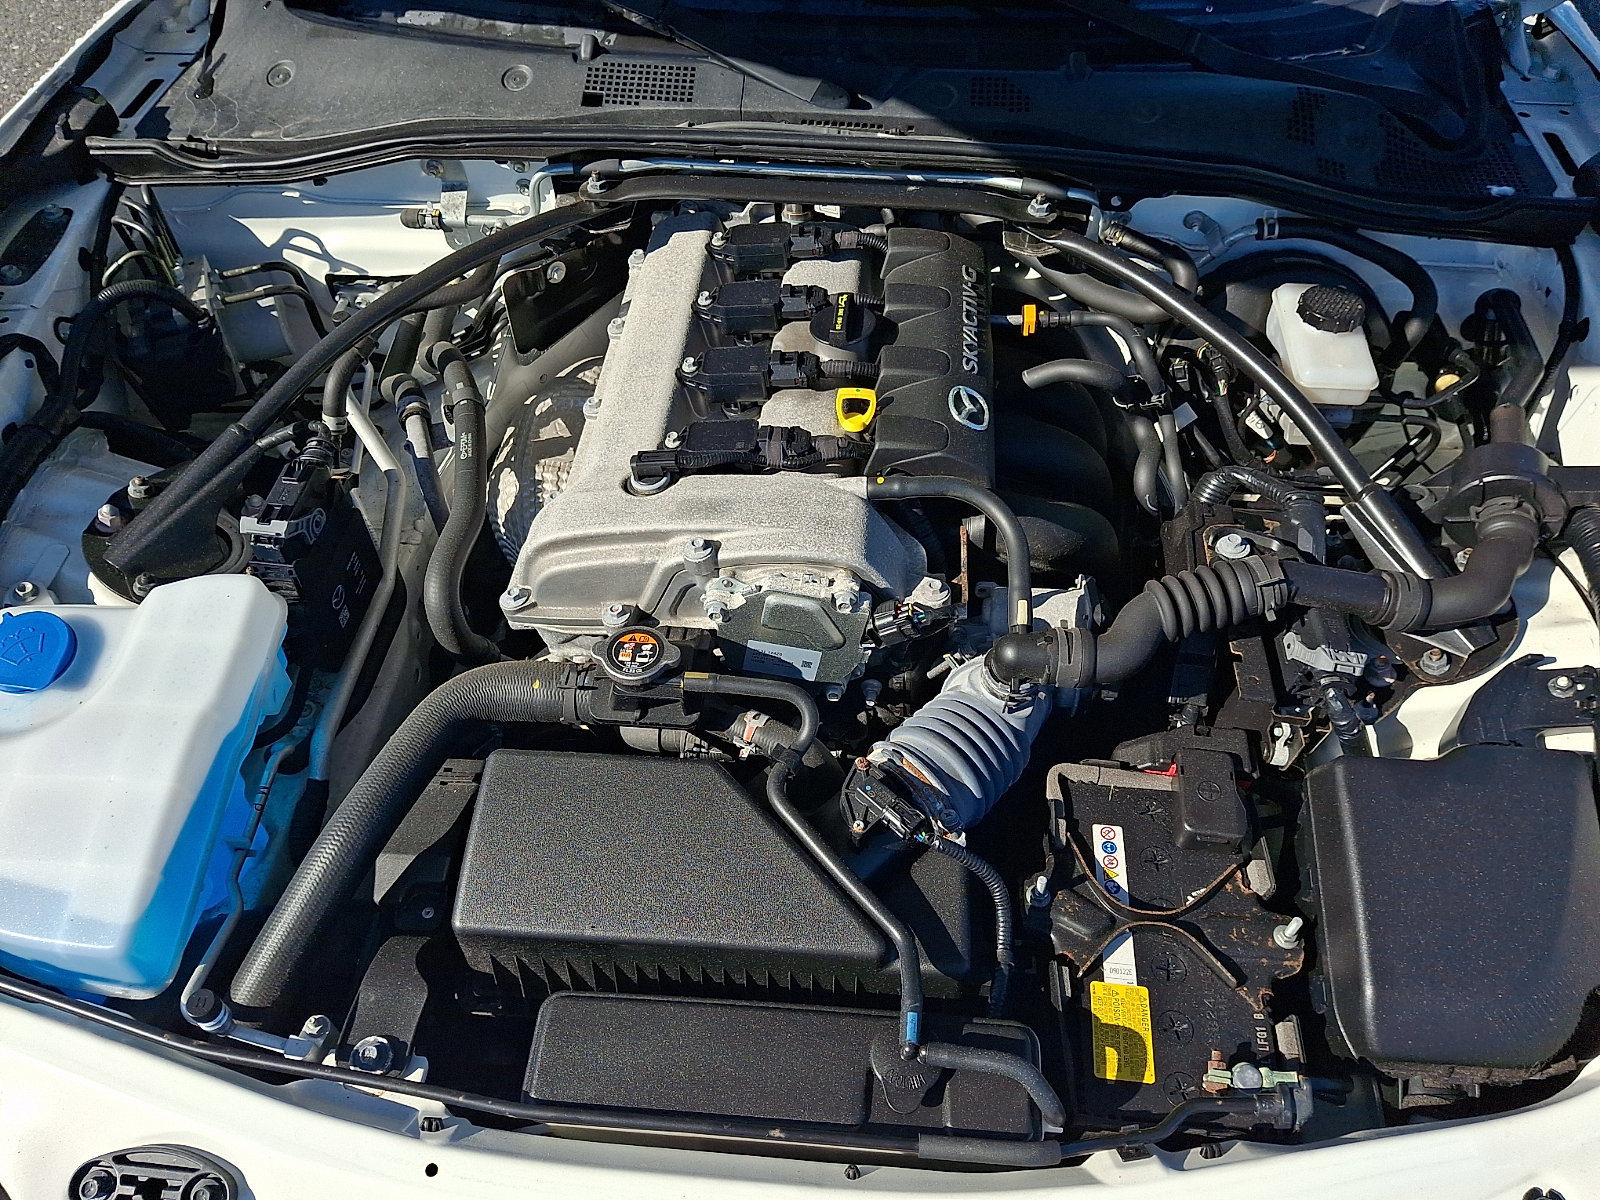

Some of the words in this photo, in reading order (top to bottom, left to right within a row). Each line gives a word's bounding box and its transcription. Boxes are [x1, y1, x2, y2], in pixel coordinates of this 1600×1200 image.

[962, 265, 978, 374] SKYACTIV-G
[1112, 998, 1121, 1021] POISON
[1140, 1003, 1149, 1032] DANGER
